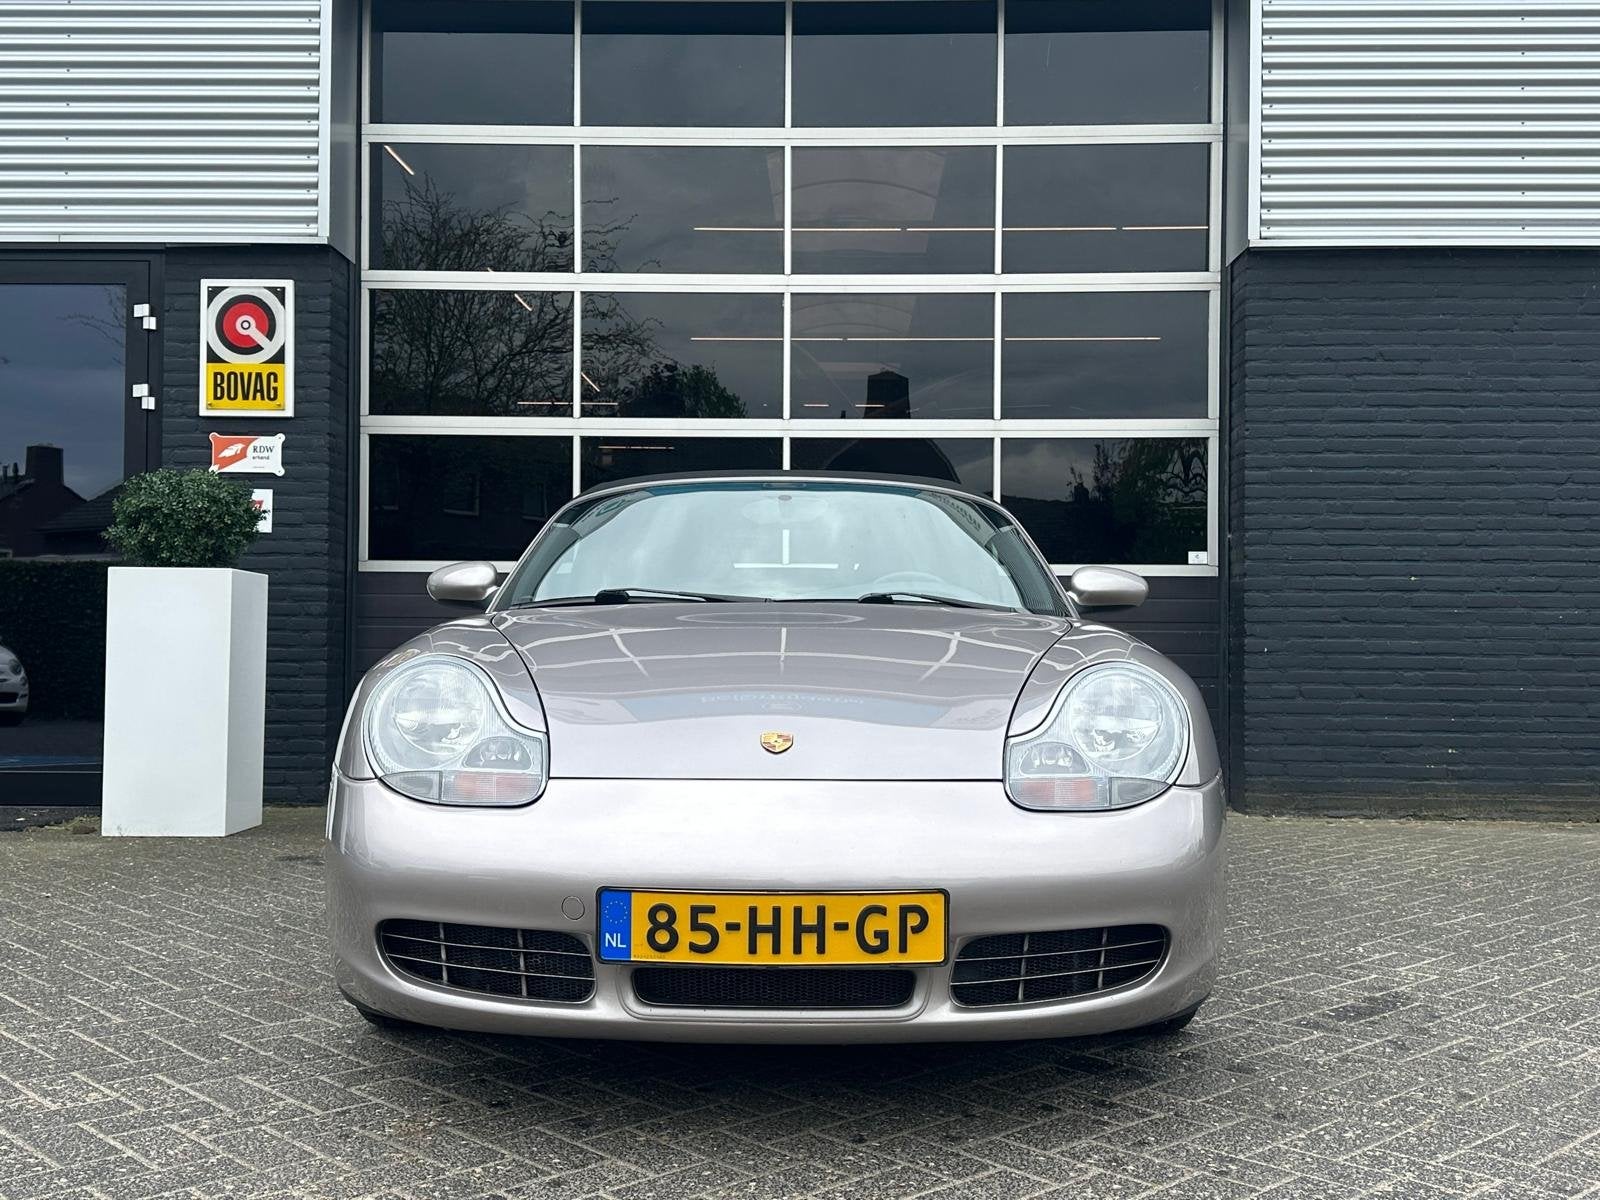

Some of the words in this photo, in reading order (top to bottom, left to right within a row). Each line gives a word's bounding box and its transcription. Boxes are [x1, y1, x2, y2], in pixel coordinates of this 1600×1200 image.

[213, 371, 278, 402] BOVAG
[252, 445, 275, 454] RDW
[605, 933, 626, 948] NL
[646, 903, 929, 955] 85-HH-GP
